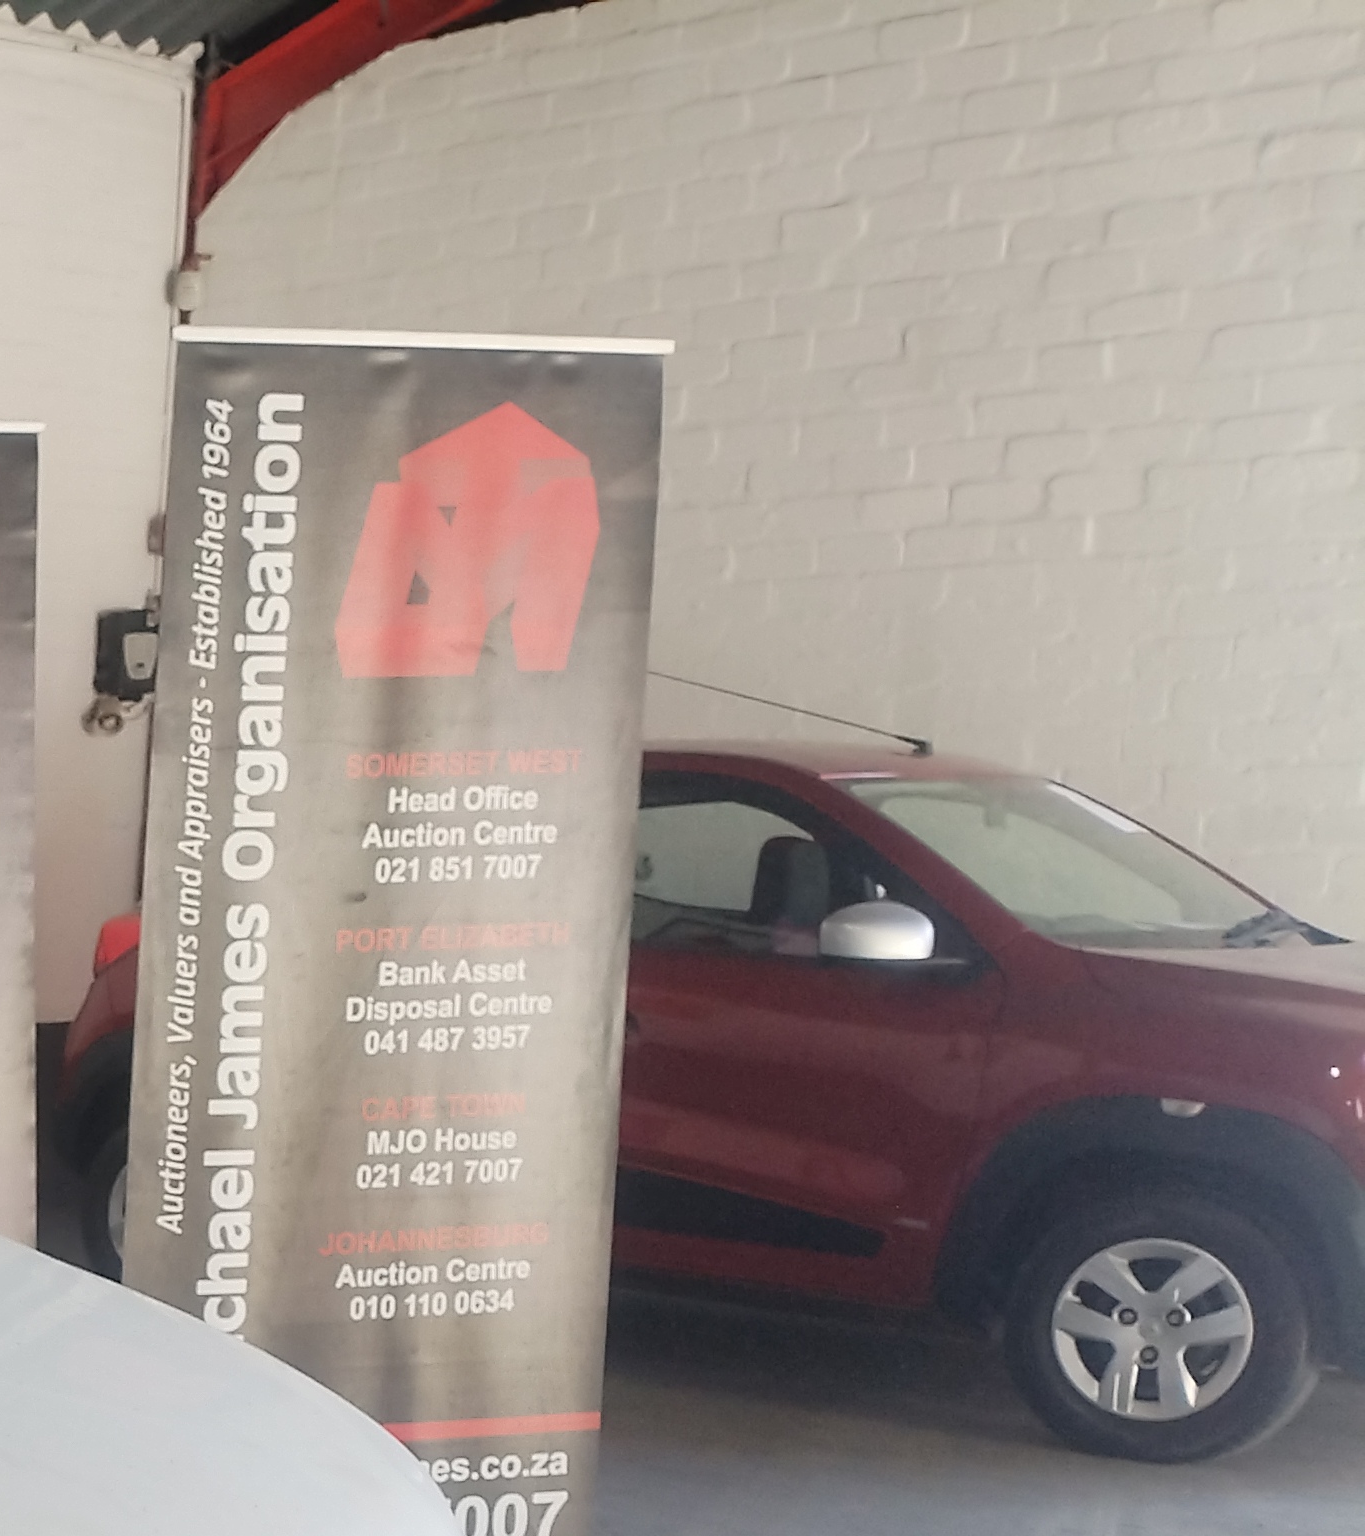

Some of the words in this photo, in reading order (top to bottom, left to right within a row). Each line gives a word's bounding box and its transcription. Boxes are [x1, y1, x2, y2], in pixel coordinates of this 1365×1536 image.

[199, 399, 234, 480] 1964
[189, 488, 228, 671] Established
[222, 393, 305, 881] Organisation
[178, 696, 214, 860] Appraisers
[345, 751, 499, 779] SOMERSET
[508, 750, 582, 774] WEST
[388, 786, 458, 813] Head
[463, 785, 539, 811] Office
[362, 822, 466, 850] Auction
[474, 819, 557, 846] Centre
[375, 858, 422, 885] 021
[429, 856, 475, 883] 851
[484, 853, 542, 880] 7007
[174, 864, 203, 925] and
[336, 927, 411, 954] PORT
[168, 933, 200, 1043] Valuers
[379, 960, 446, 987] Bank
[453, 958, 526, 983] Asset
[208, 902, 271, 1131] James
[345, 994, 461, 1026] Disposal
[469, 991, 552, 1017] Centre
[364, 1029, 409, 1056] 041
[418, 1027, 462, 1054] 487
[472, 1025, 531, 1051] 3957
[362, 1096, 438, 1122] CAPE
[155, 1054, 197, 1234] Auctioneers,
[367, 1129, 427, 1156] MJO
[434, 1127, 517, 1151] House
[357, 1164, 401, 1191] 021
[410, 1161, 456, 1187] 421
[464, 1159, 523, 1185] 7007
[196, 1149, 255, 1341] chael
[319, 1223, 549, 1257] JOHANNESBURG
[336, 1262, 438, 1290] Auction
[446, 1257, 531, 1283] Centre
[350, 1293, 395, 1320] 010
[404, 1291, 447, 1317] 110
[455, 1288, 515, 1316] 0634
